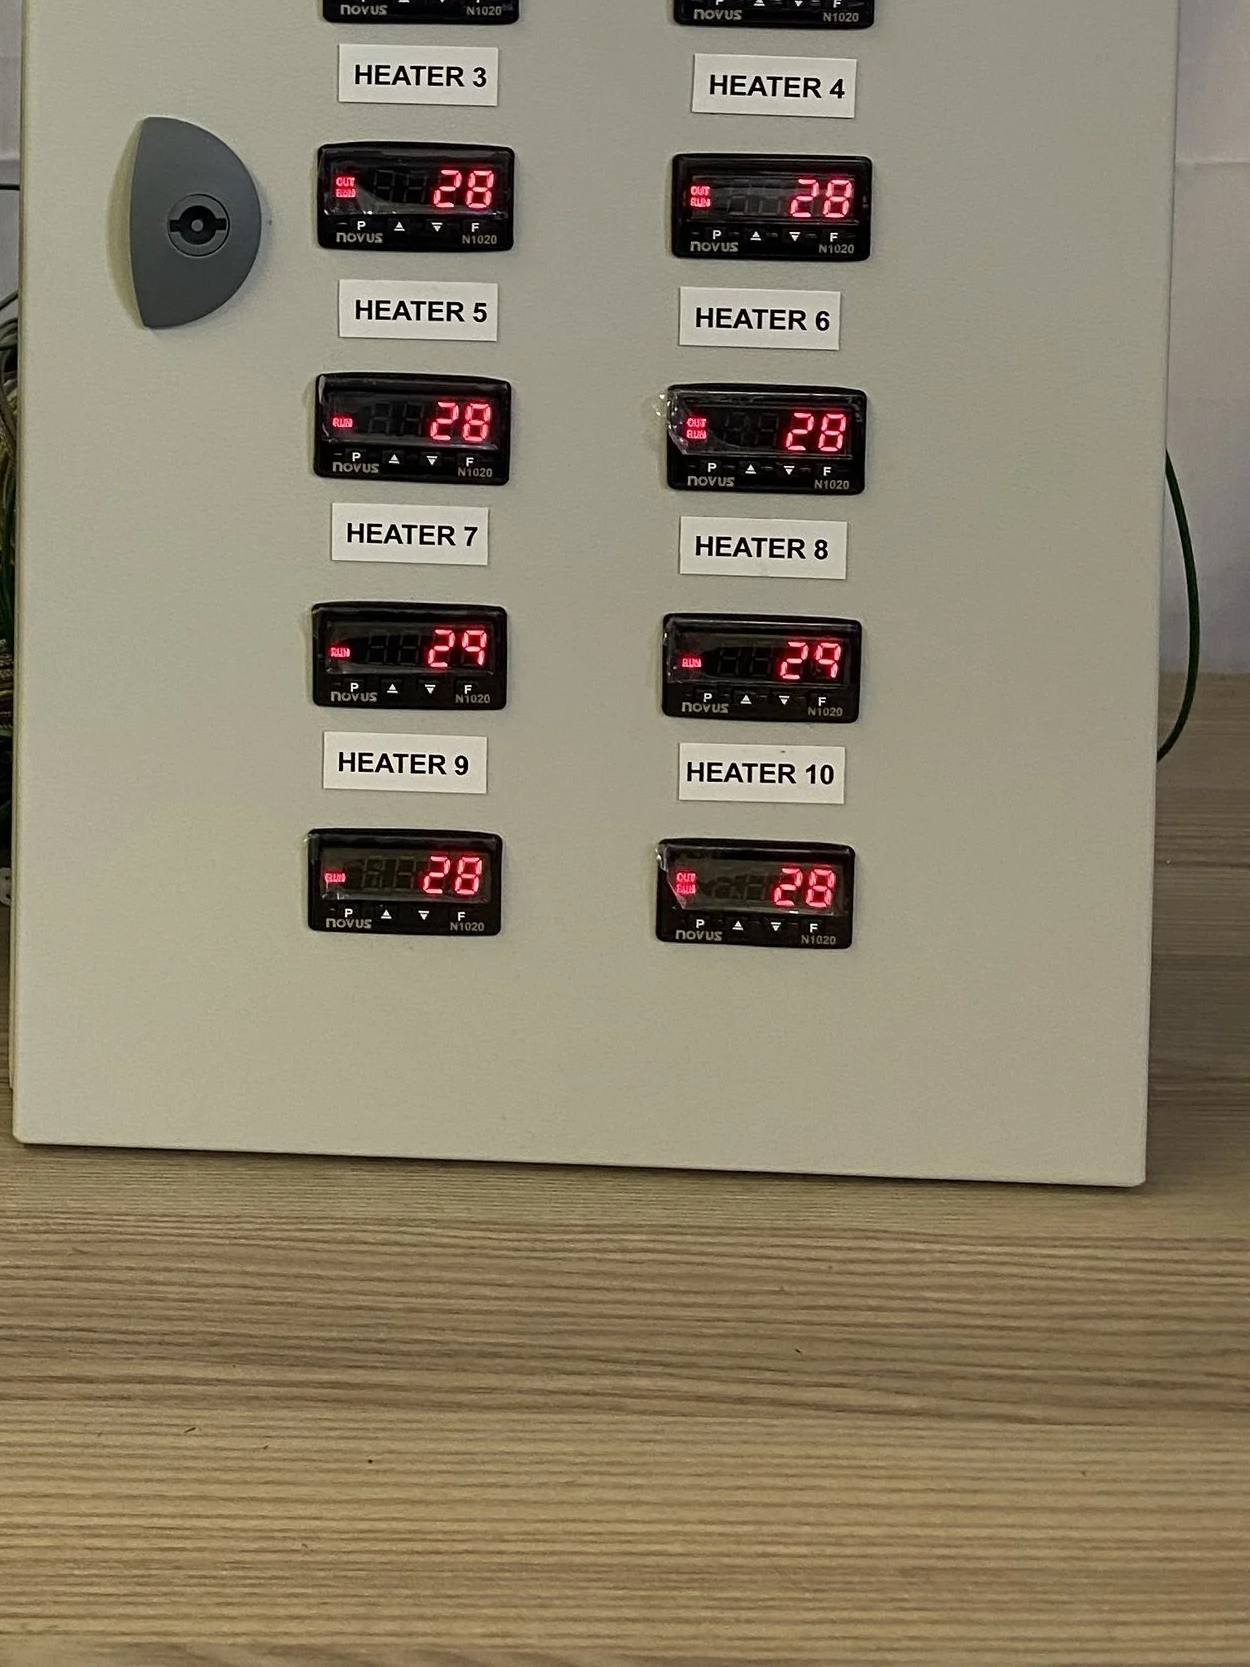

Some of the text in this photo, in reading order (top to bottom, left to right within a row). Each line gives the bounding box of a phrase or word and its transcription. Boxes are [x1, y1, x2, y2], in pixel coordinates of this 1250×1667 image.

[834, 0, 841, 7] F
[467, 6, 502, 15] N1020
[824, 13, 858, 22] N1020
[355, 65, 486, 87] HEATER 3
[710, 75, 845, 98] HEATER 4
[434, 170, 494, 208] 28
[790, 179, 852, 218] 28
[358, 221, 366, 230] P
[472, 223, 479, 232] F
[713, 230, 721, 239] P
[830, 233, 838, 242] F
[462, 235, 496, 244] N1020
[819, 244, 854, 253] N1020
[356, 300, 487, 322] HEATER 5
[696, 308, 829, 331] HEATER 6
[430, 402, 491, 442] 28
[786, 413, 846, 451] 28
[353, 453, 360, 461] P
[466, 458, 473, 466] F
[708, 463, 716, 472] P
[824, 467, 831, 476] F
[458, 468, 492, 477] N1020
[815, 480, 849, 489] N1020
[348, 523, 477, 546] HEATER 7
[696, 536, 828, 560] HEATER 8
[428, 630, 487, 668] 29
[780, 639, 841, 679] 29
[351, 683, 358, 692] P
[465, 685, 472, 694] F
[456, 694, 490, 703] N1020
[704, 693, 712, 702] P
[819, 697, 826, 706] F
[808, 707, 842, 716] N1020
[339, 752, 468, 775] HEATER 9
[687, 762, 834, 784] HEATER 10
[423, 856, 482, 895] 28
[774, 865, 835, 908] 28
[345, 909, 353, 917] P
[458, 912, 465, 921] F
[451, 921, 484, 931] N1020
[696, 919, 704, 928] P
[810, 924, 817, 932] F
[801, 935, 836, 945] N1020
